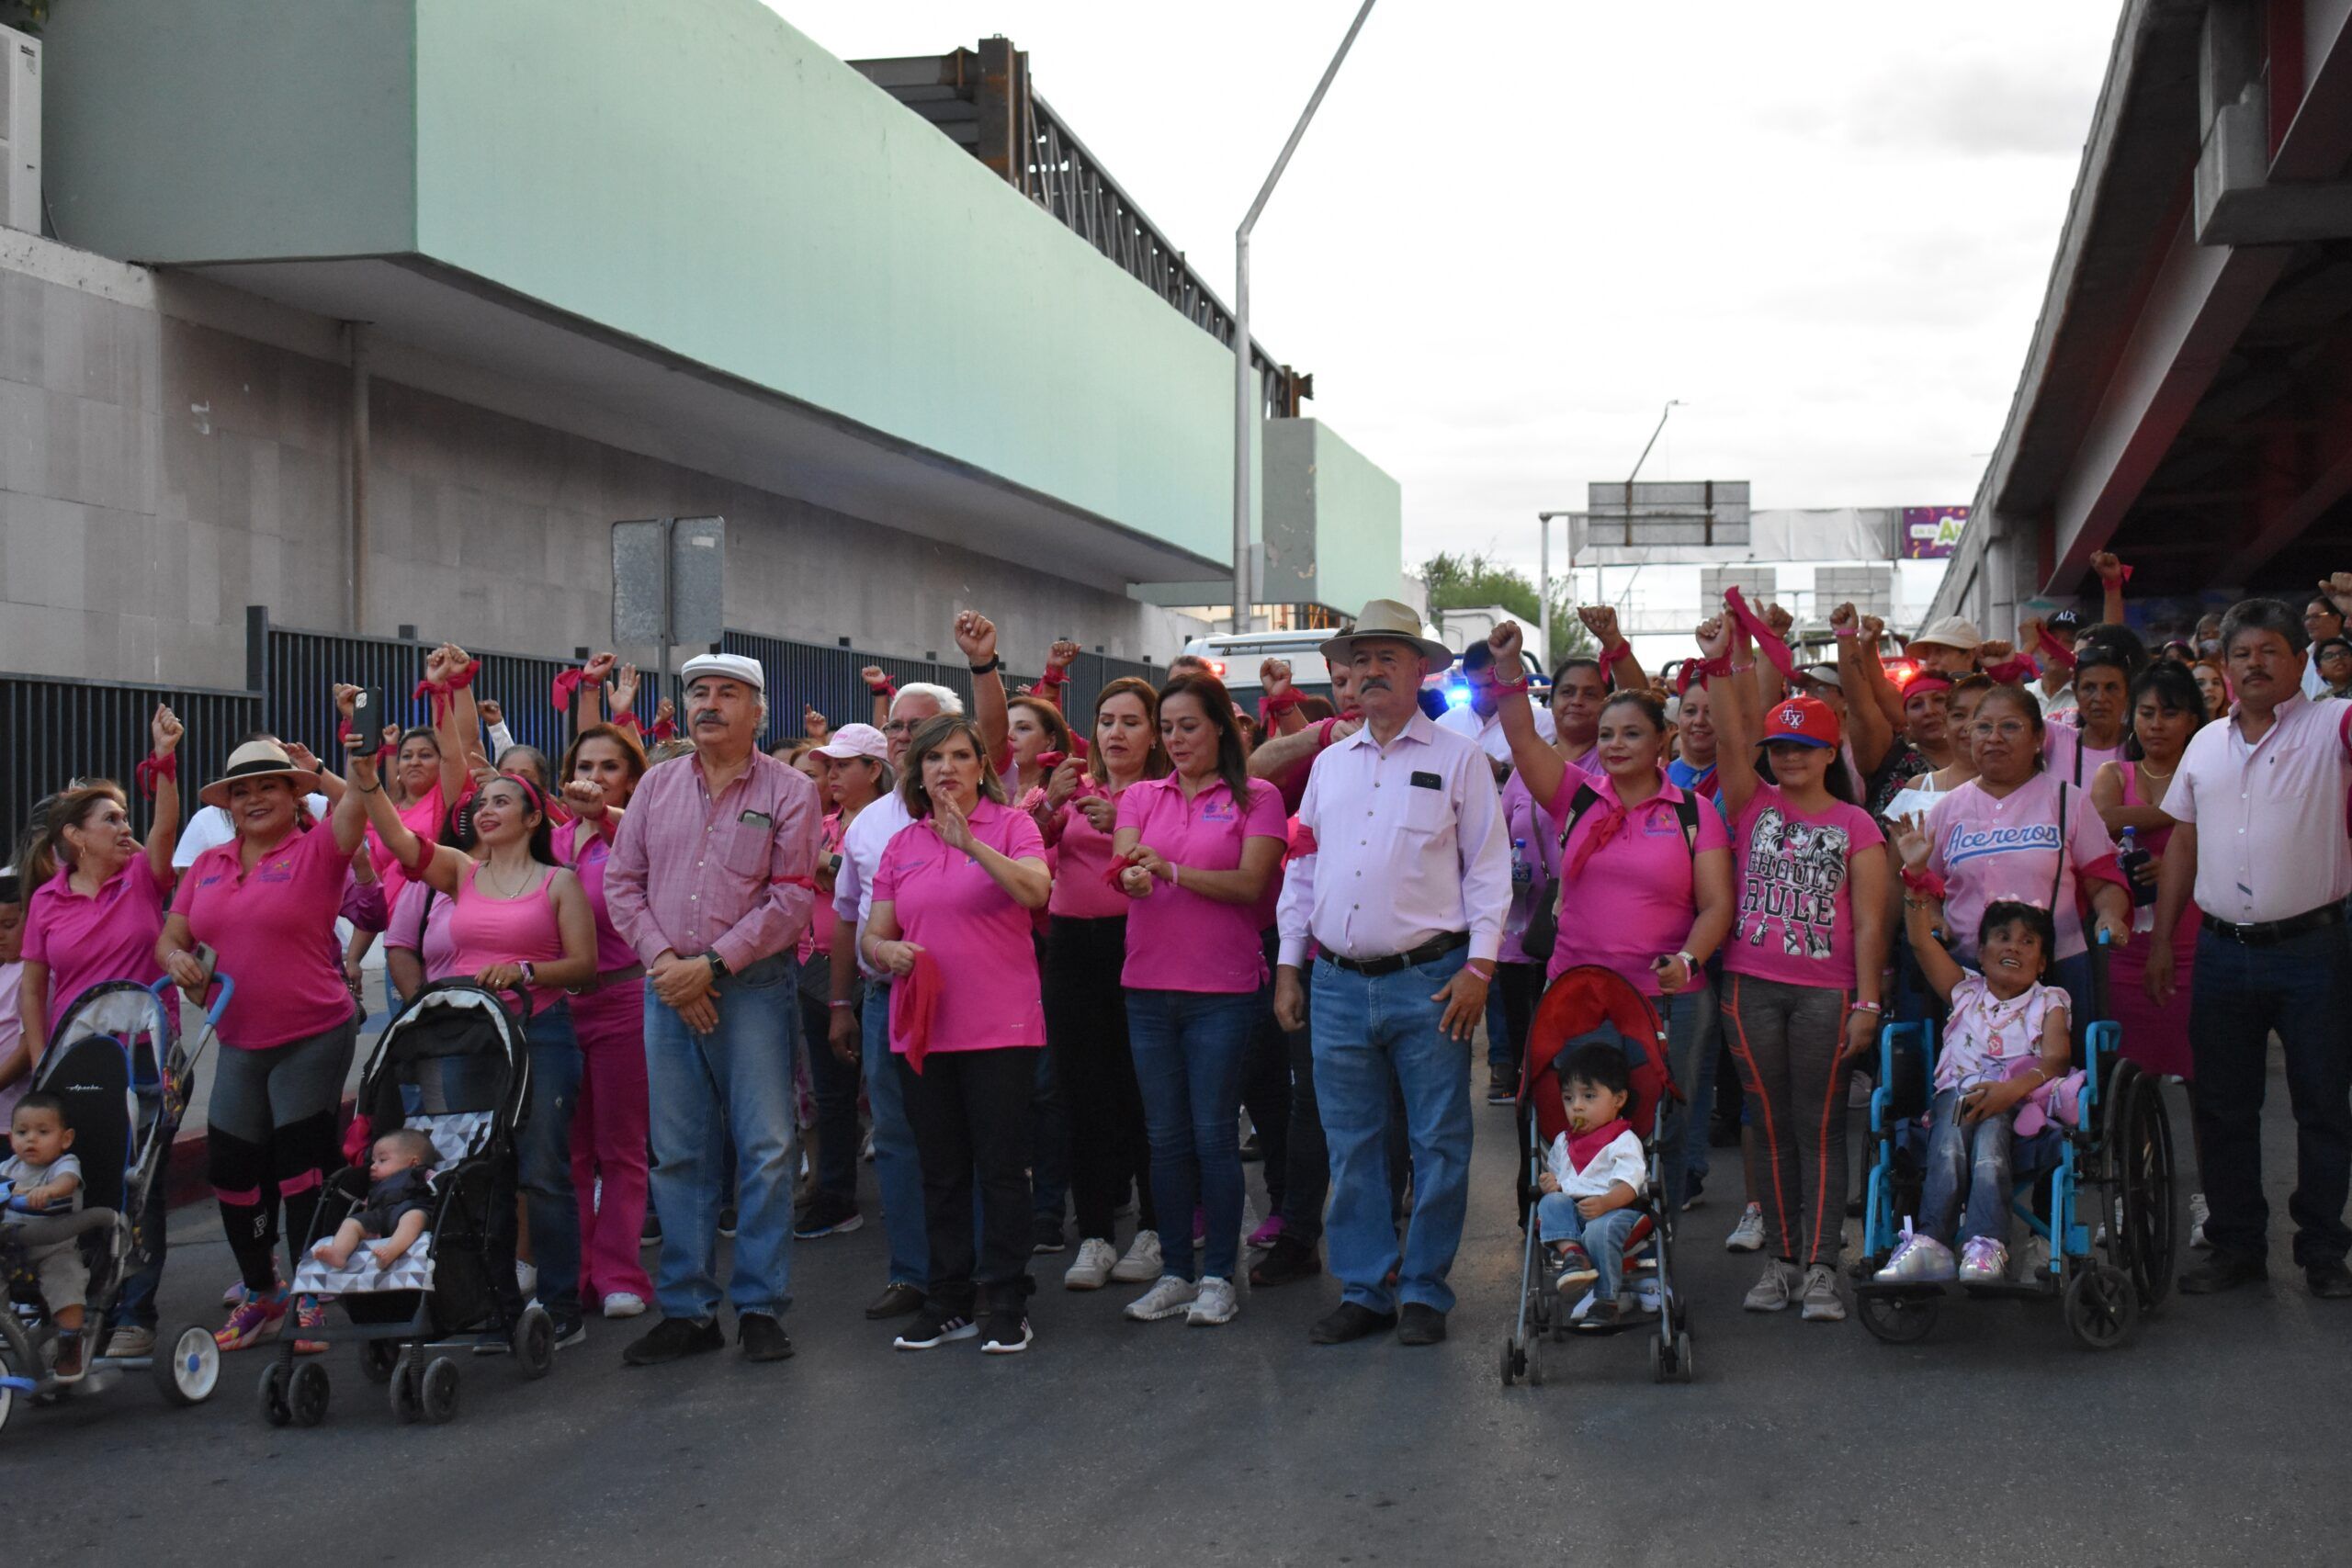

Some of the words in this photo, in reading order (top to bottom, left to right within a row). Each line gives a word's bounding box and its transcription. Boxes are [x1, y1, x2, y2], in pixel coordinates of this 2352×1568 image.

[1943, 823, 2060, 859] Acereros
[1747, 851, 1840, 893] GHOULS
[1741, 878, 1835, 927] RULE
